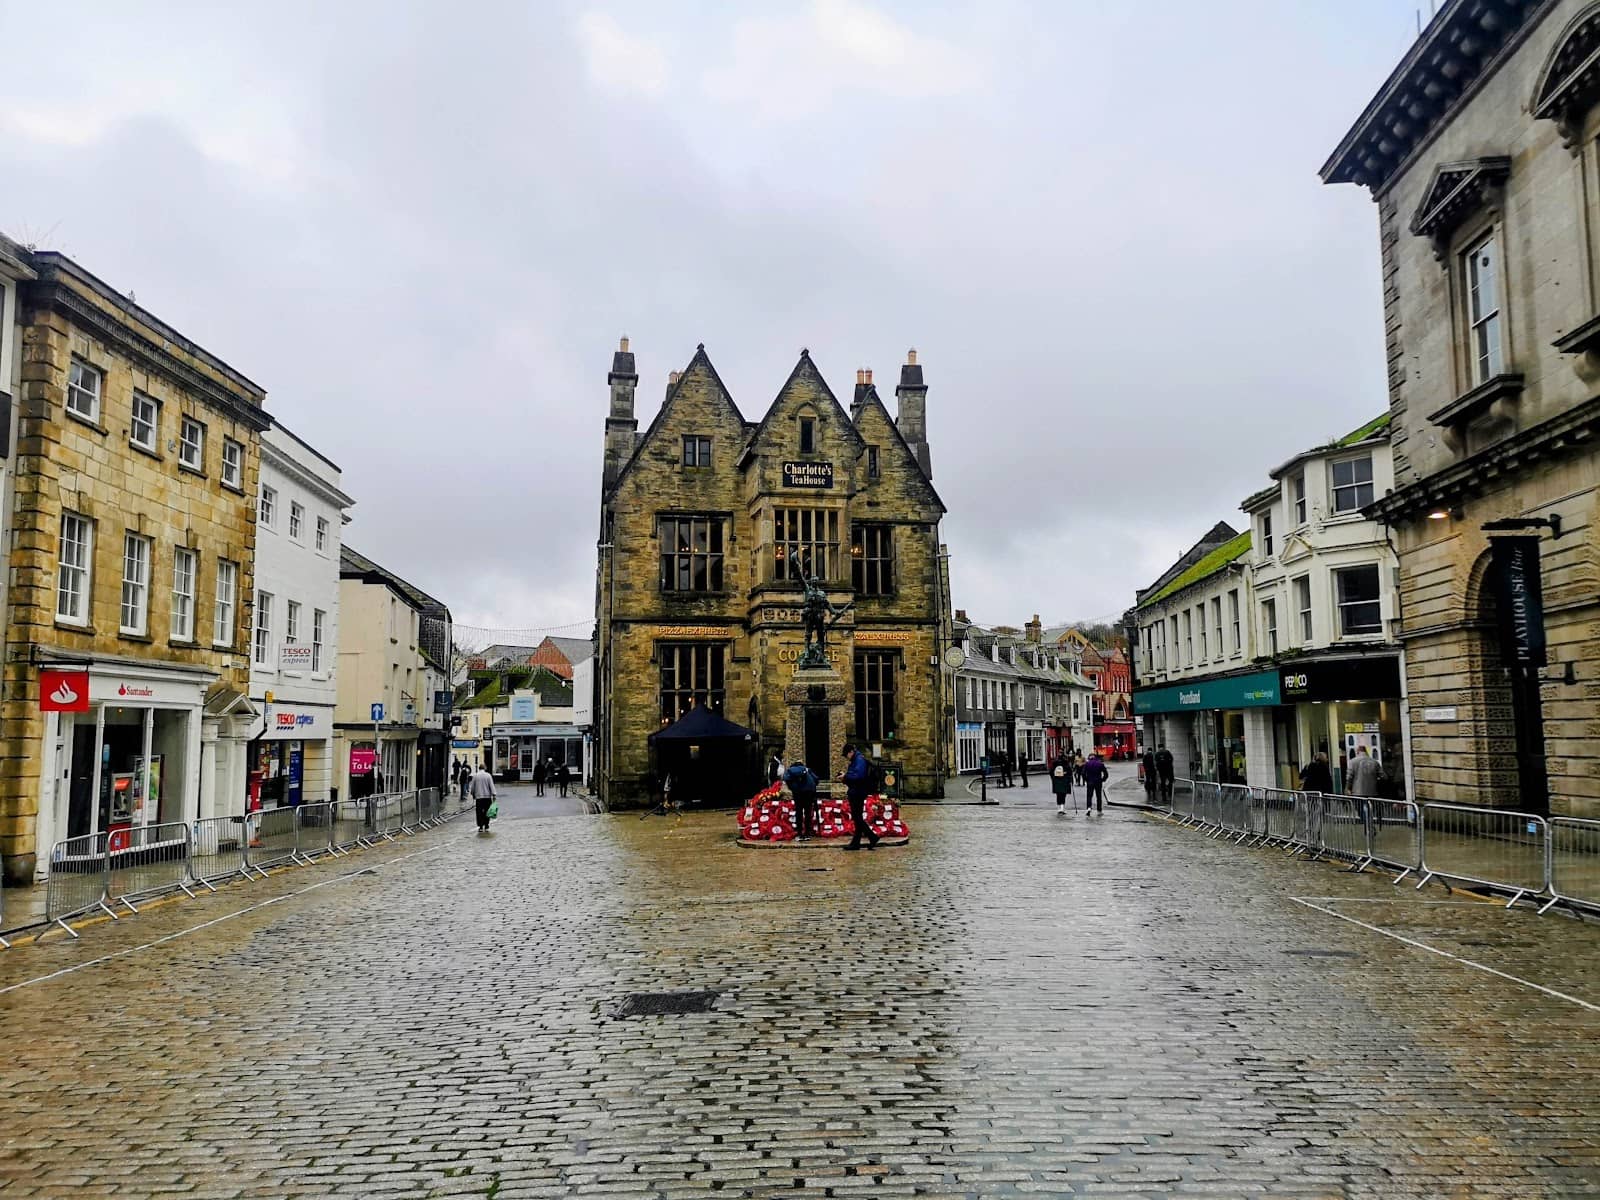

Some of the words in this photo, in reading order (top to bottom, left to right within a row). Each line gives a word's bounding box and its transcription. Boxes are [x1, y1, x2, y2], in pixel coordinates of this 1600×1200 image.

[784, 463, 832, 476] Charlotte's
[1511, 574, 1531, 660] PLAYHOUSE
[658, 626, 684, 636] PIZZA
[686, 626, 729, 636] EXPRESS
[126, 685, 153, 697] Santander
[1179, 689, 1201, 705] Poundland
[276, 713, 295, 725] TESCO
[296, 713, 314, 728] express
[352, 762, 363, 770] To
[363, 762, 373, 770] Le
